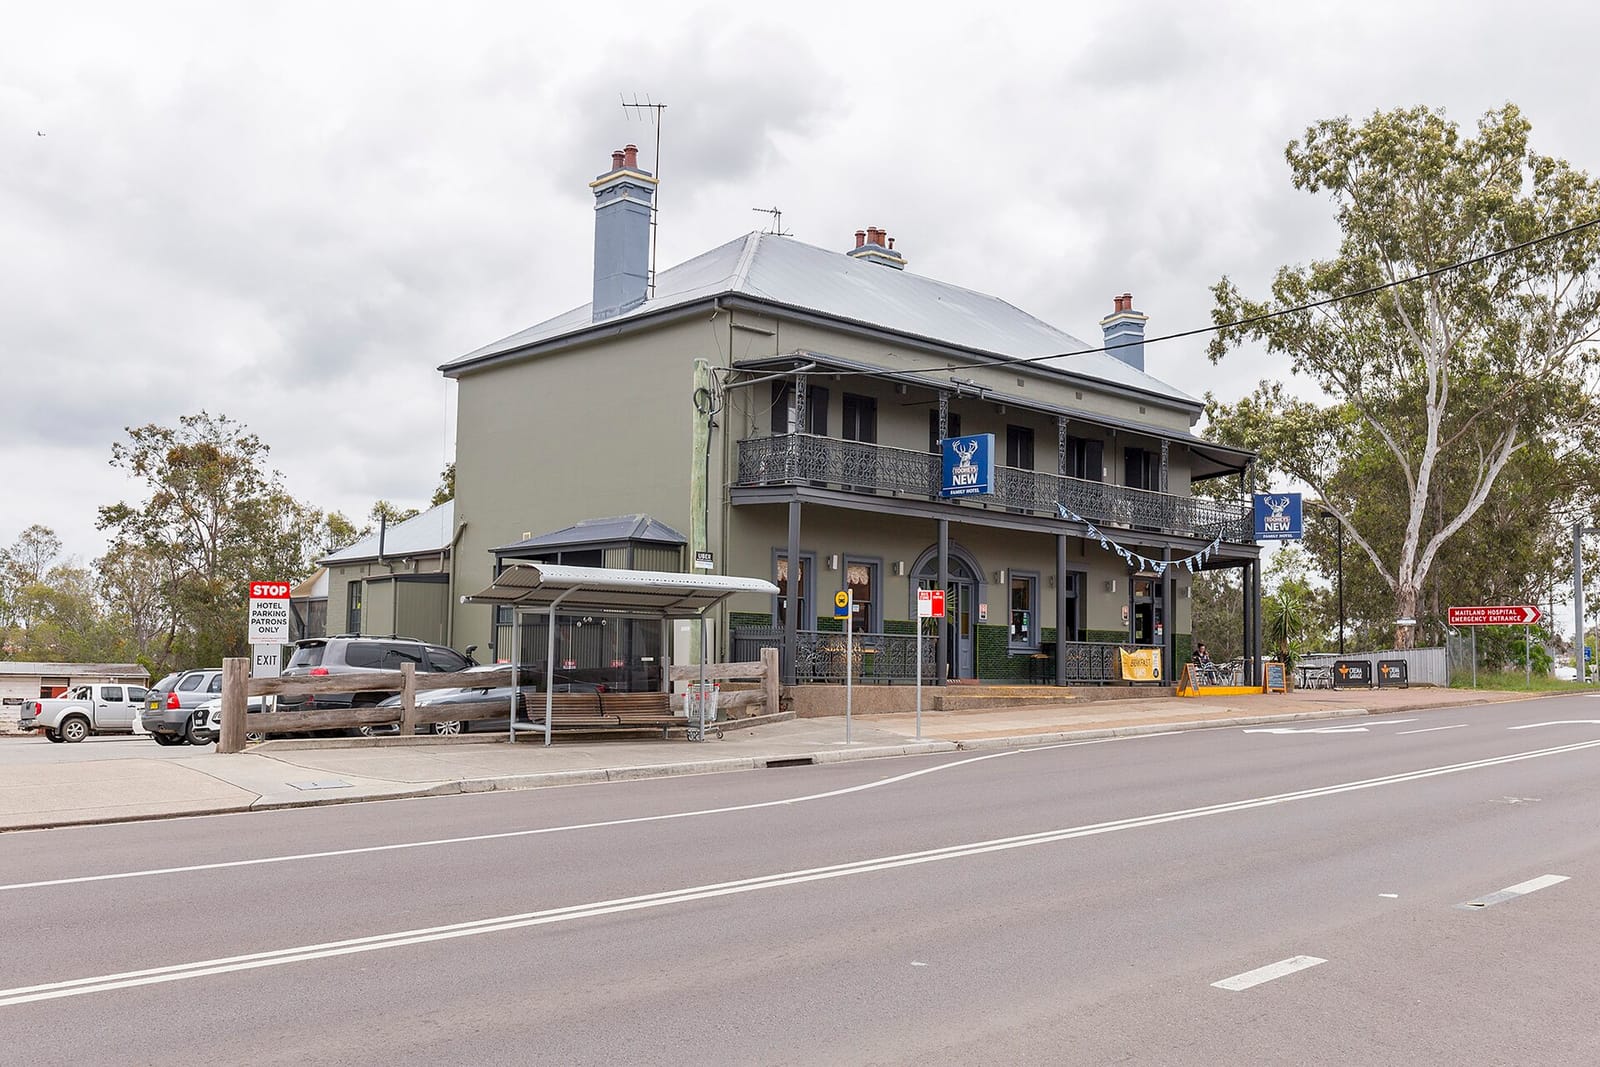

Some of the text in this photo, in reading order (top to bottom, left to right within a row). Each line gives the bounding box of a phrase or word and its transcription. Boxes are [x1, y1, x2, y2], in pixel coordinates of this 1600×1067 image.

[952, 473, 978, 486] NEW
[1264, 522, 1290, 531] NEW
[253, 585, 287, 596] STOP
[256, 655, 277, 666] EXIT
